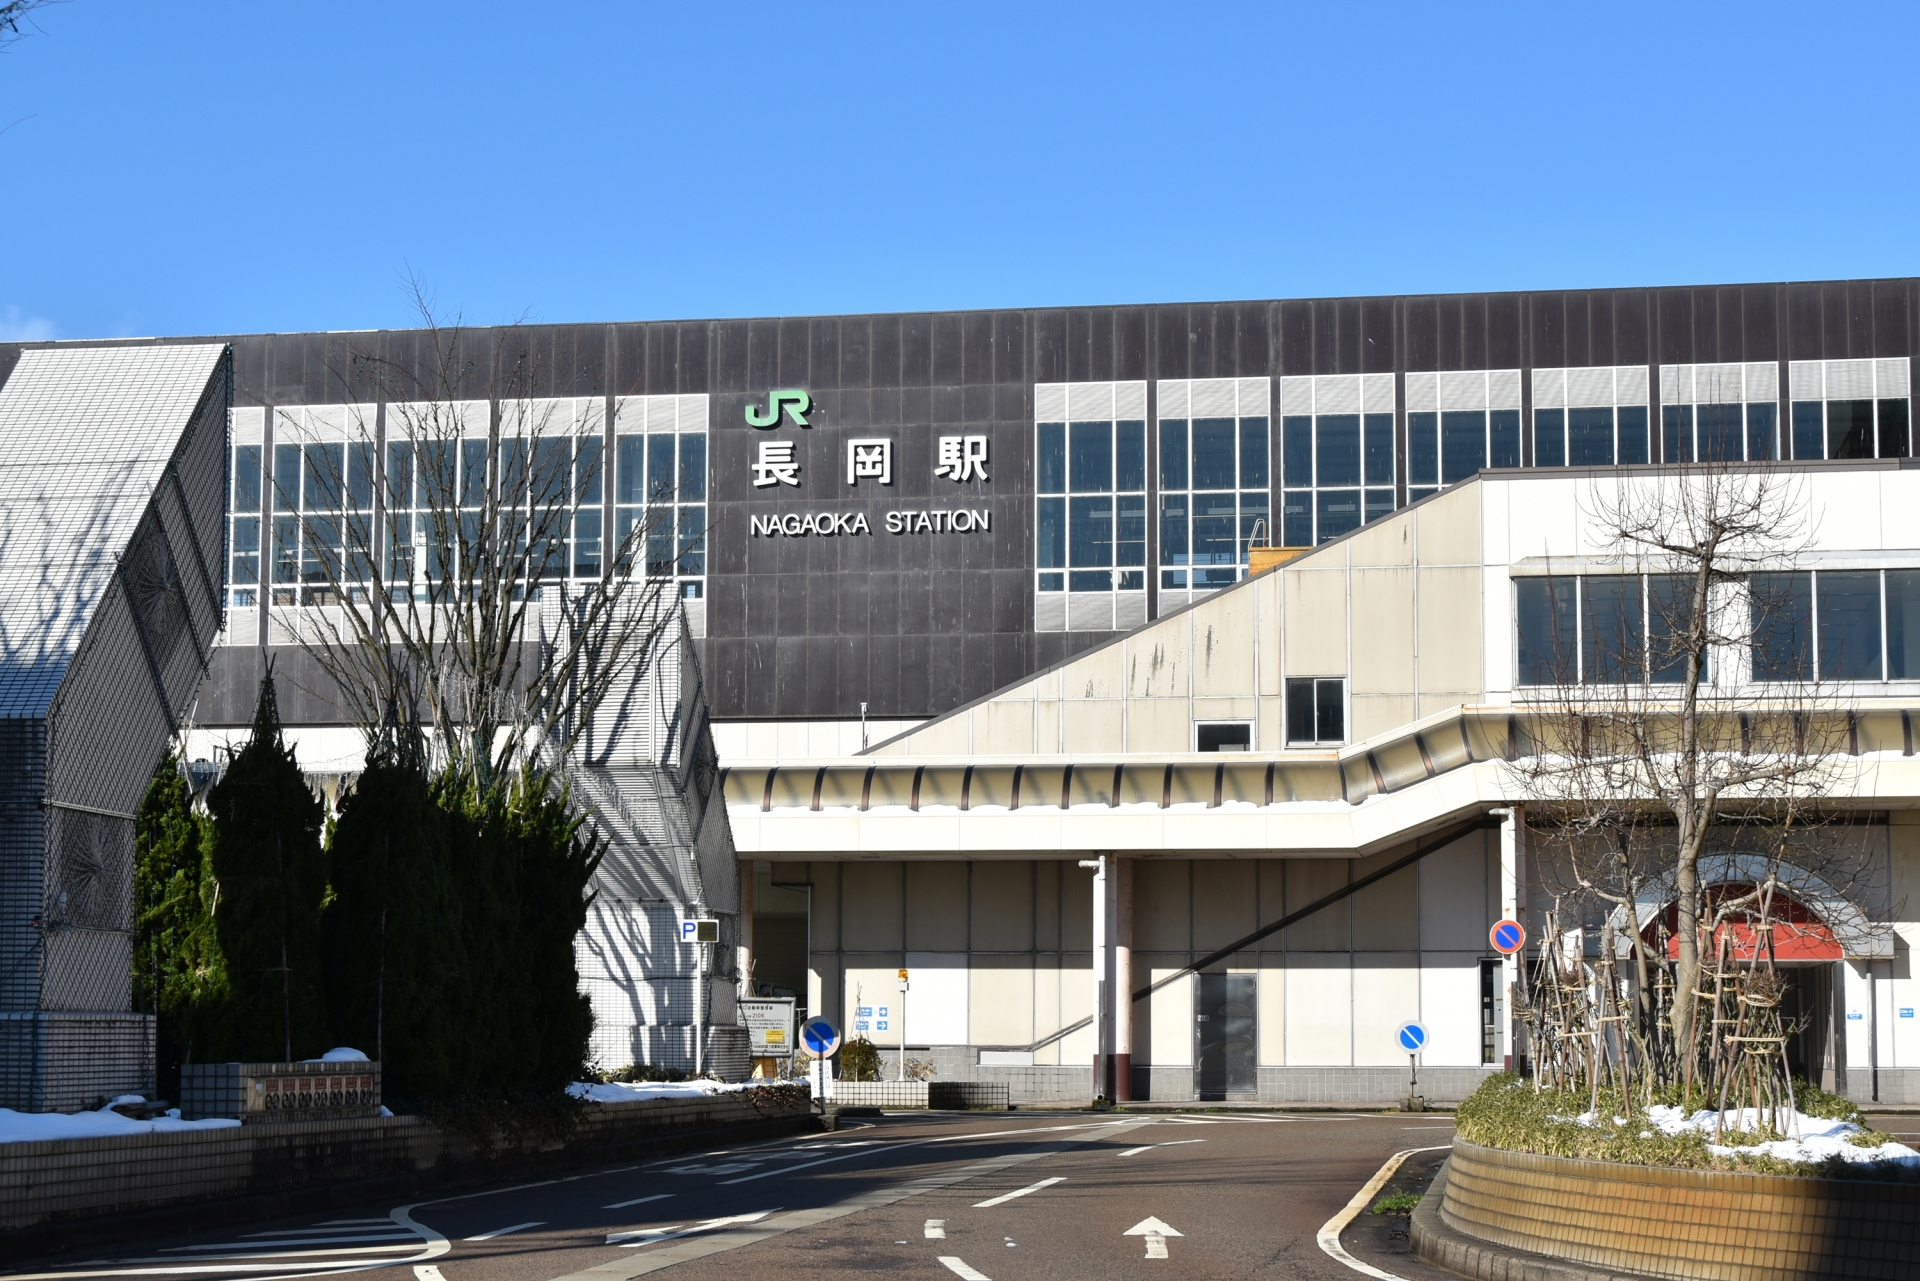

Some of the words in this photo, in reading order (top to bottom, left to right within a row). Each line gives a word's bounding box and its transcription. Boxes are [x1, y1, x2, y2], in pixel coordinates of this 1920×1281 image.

[744, 390, 810, 427] JR
[752, 435, 988, 487] 長岡駅
[751, 512, 870, 535] NAGAOKA
[885, 509, 989, 533] STATION
[683, 922, 697, 940] P
